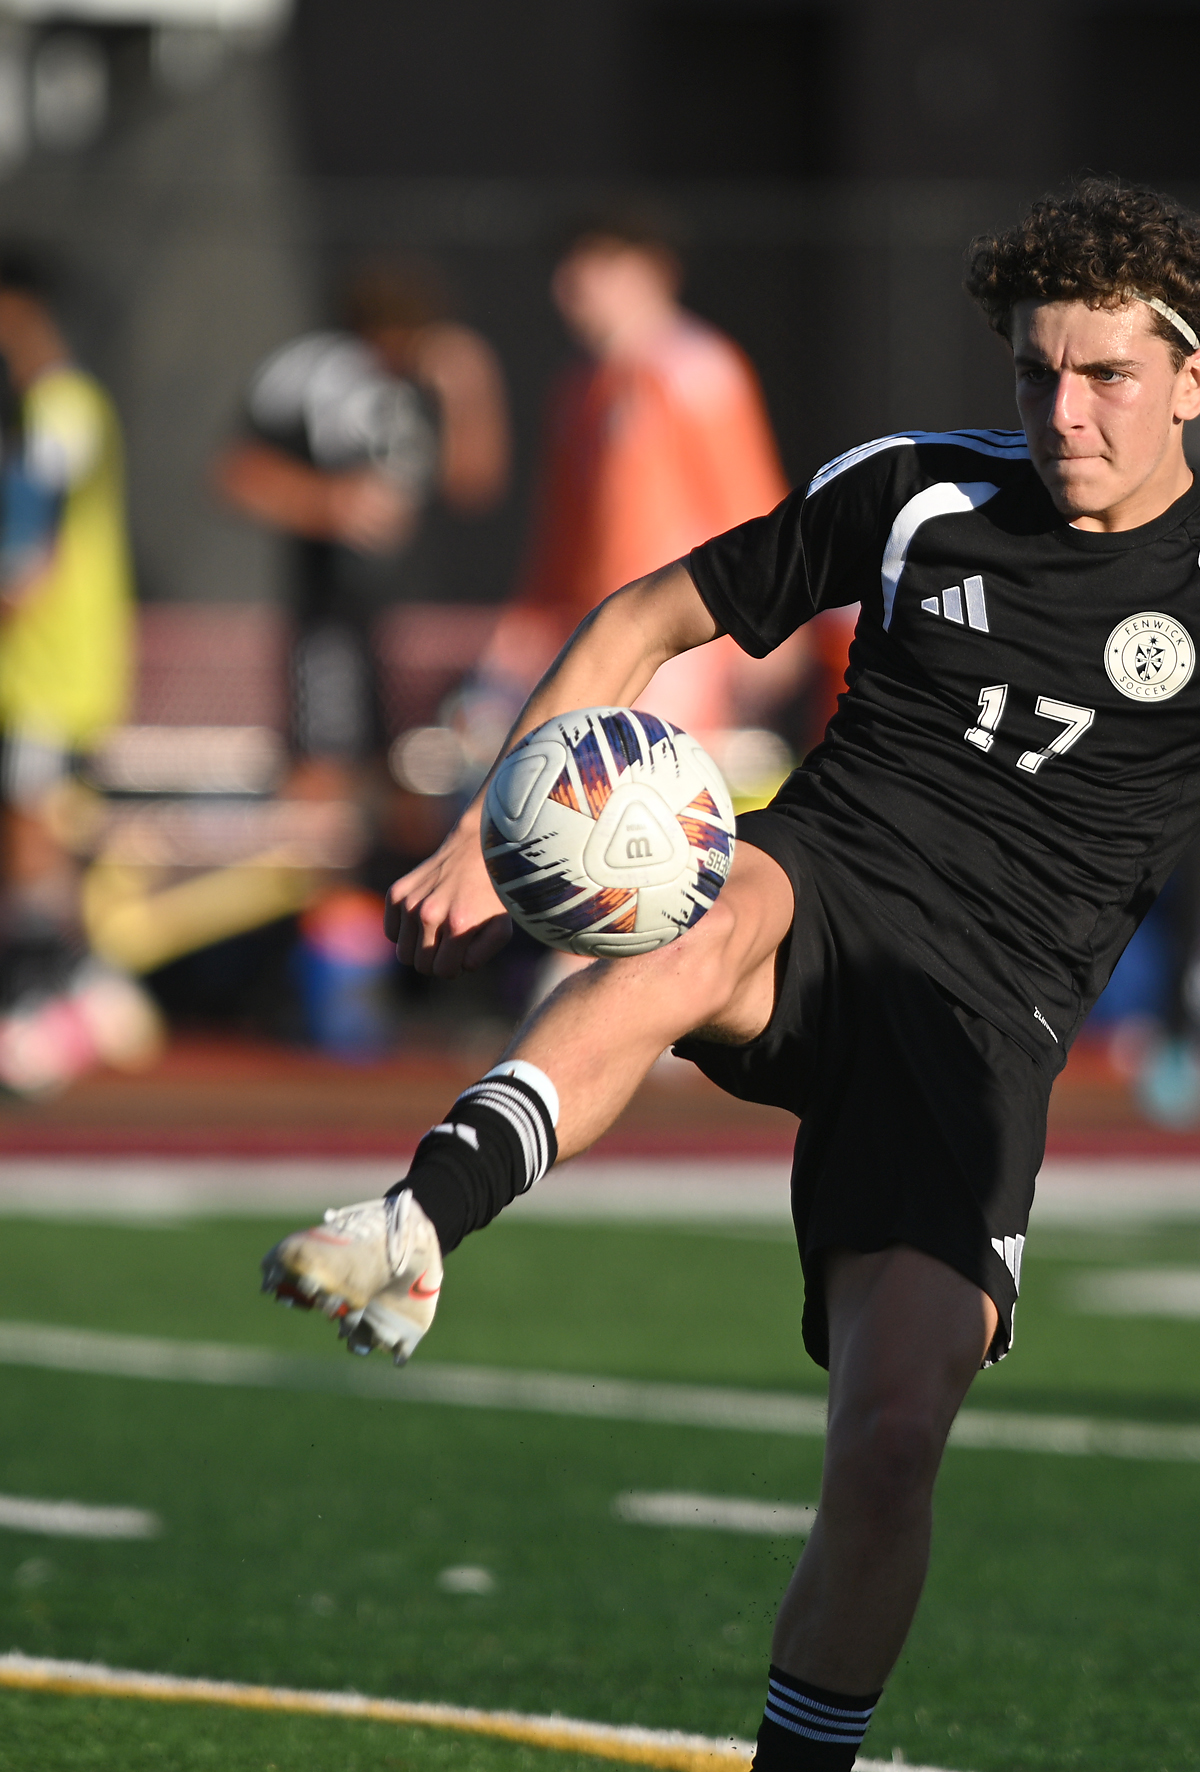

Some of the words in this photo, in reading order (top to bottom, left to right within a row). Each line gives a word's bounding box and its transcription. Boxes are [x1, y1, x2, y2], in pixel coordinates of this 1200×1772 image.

[1124, 619, 1185, 646] FENWICK
[1119, 675, 1168, 696] SOCCER
[963, 683, 1096, 775] 17
